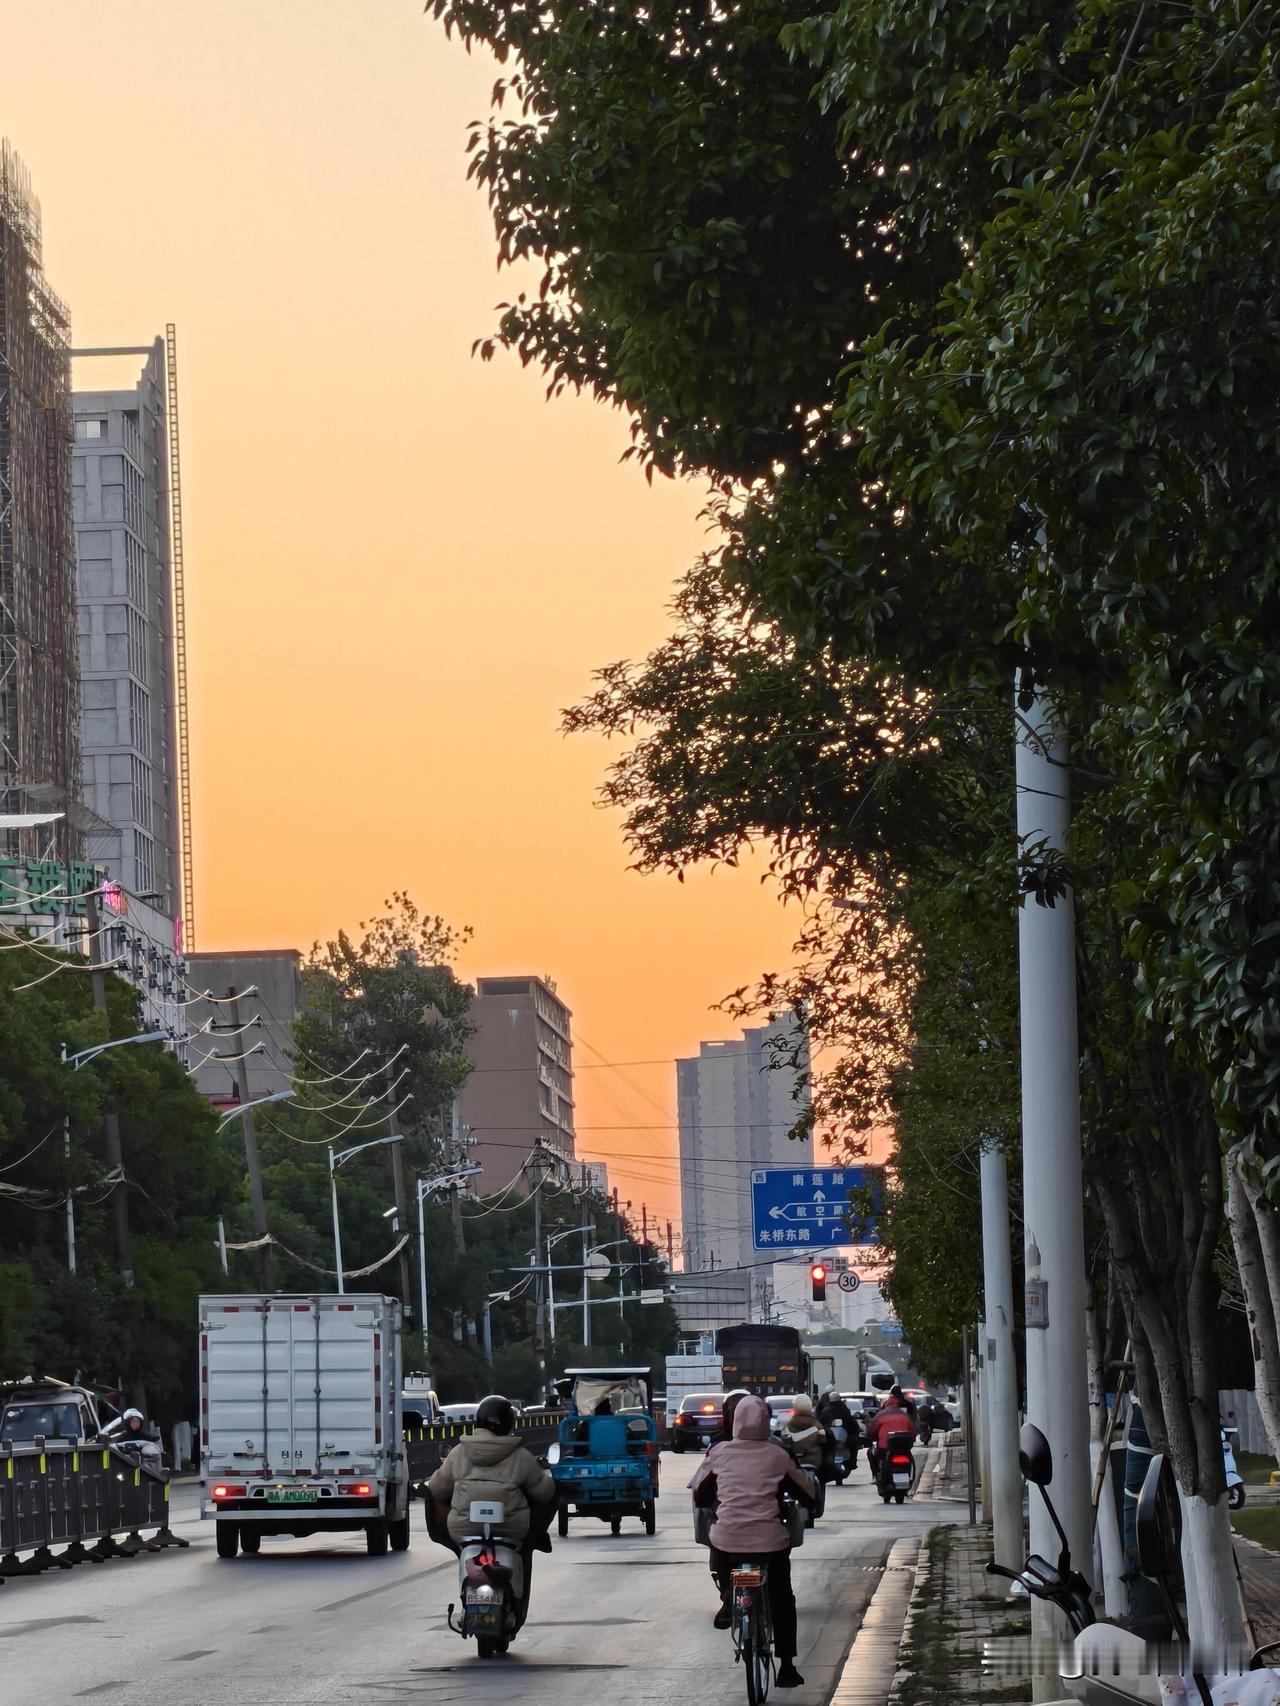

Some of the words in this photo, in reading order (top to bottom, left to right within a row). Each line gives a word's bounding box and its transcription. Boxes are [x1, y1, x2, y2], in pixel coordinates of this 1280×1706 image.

[759, 1229, 811, 1242] 朱桥东路
[842, 1276, 857, 1287] 30
